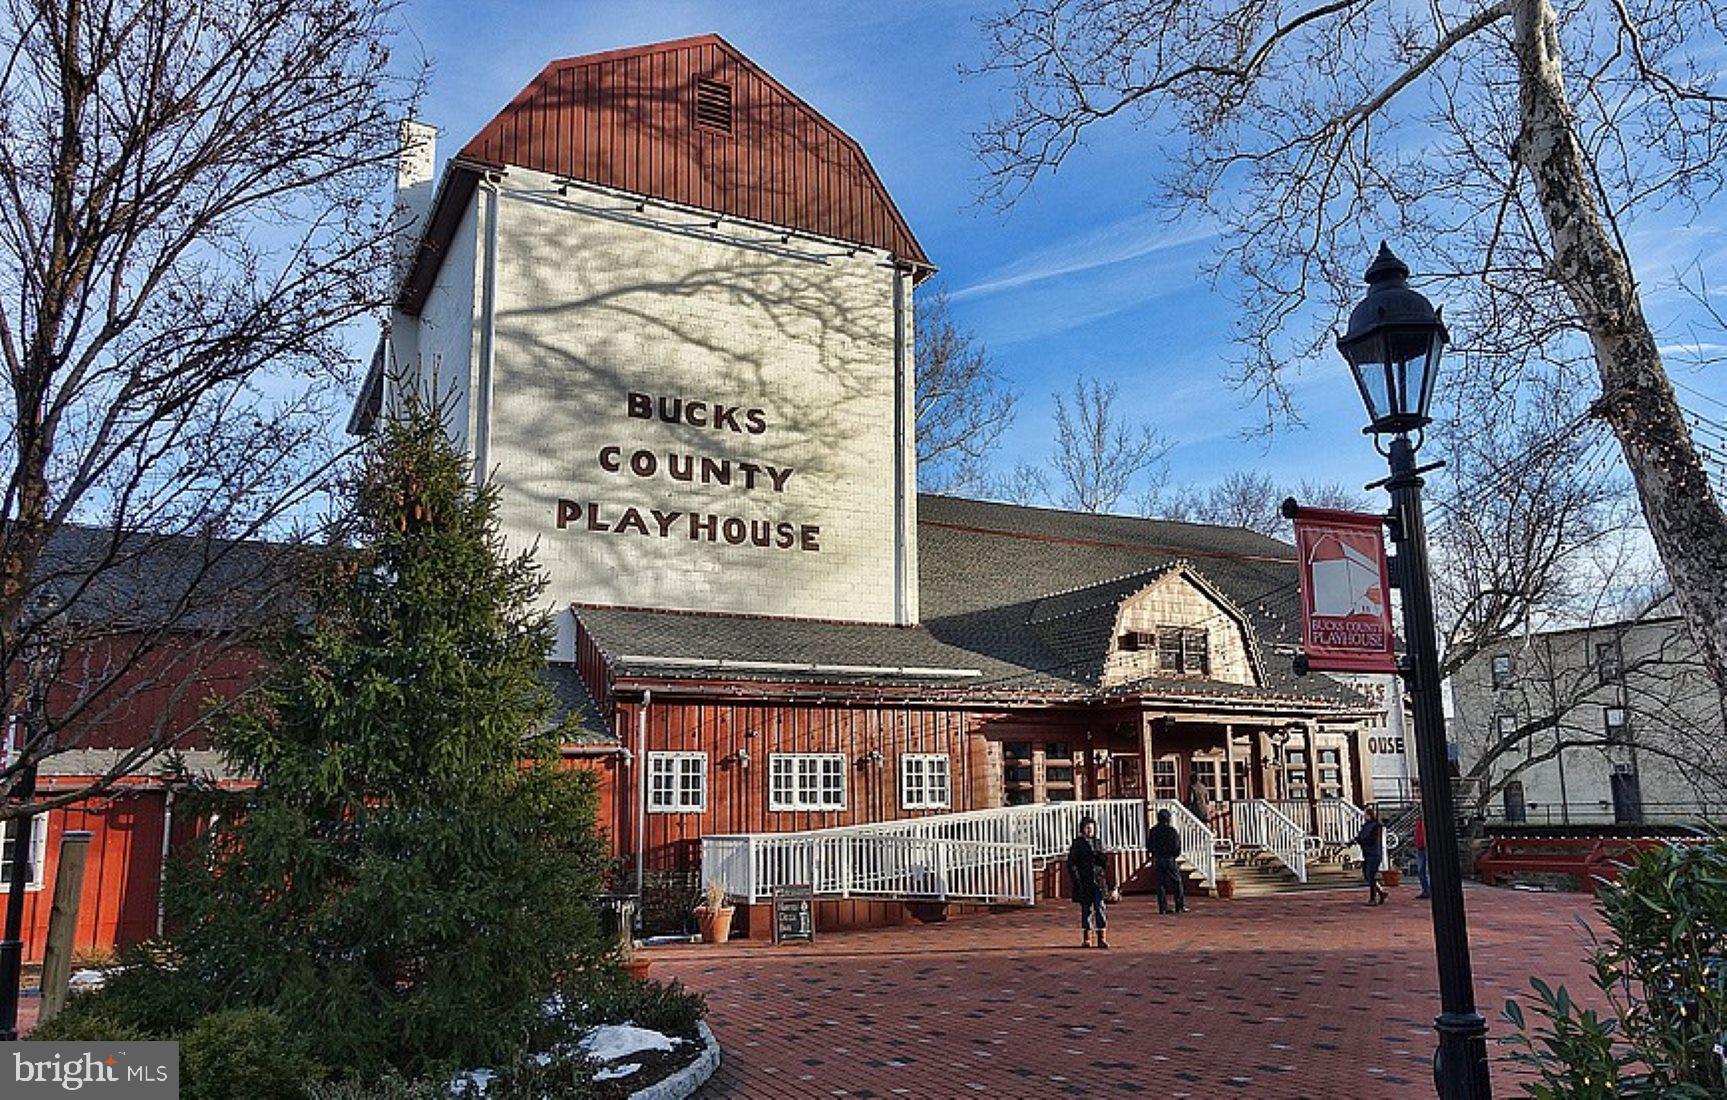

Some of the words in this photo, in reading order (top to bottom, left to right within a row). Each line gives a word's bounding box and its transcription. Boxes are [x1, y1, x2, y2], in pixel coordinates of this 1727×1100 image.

[627, 392, 767, 434] BUCKS
[599, 446, 794, 492] COUNTY
[556, 498, 820, 551] PLAYHOUSE
[1312, 619, 1344, 631] BUCKS
[1346, 621, 1383, 633] COUNTY
[1312, 631, 1383, 647] PLAYHOUSE
